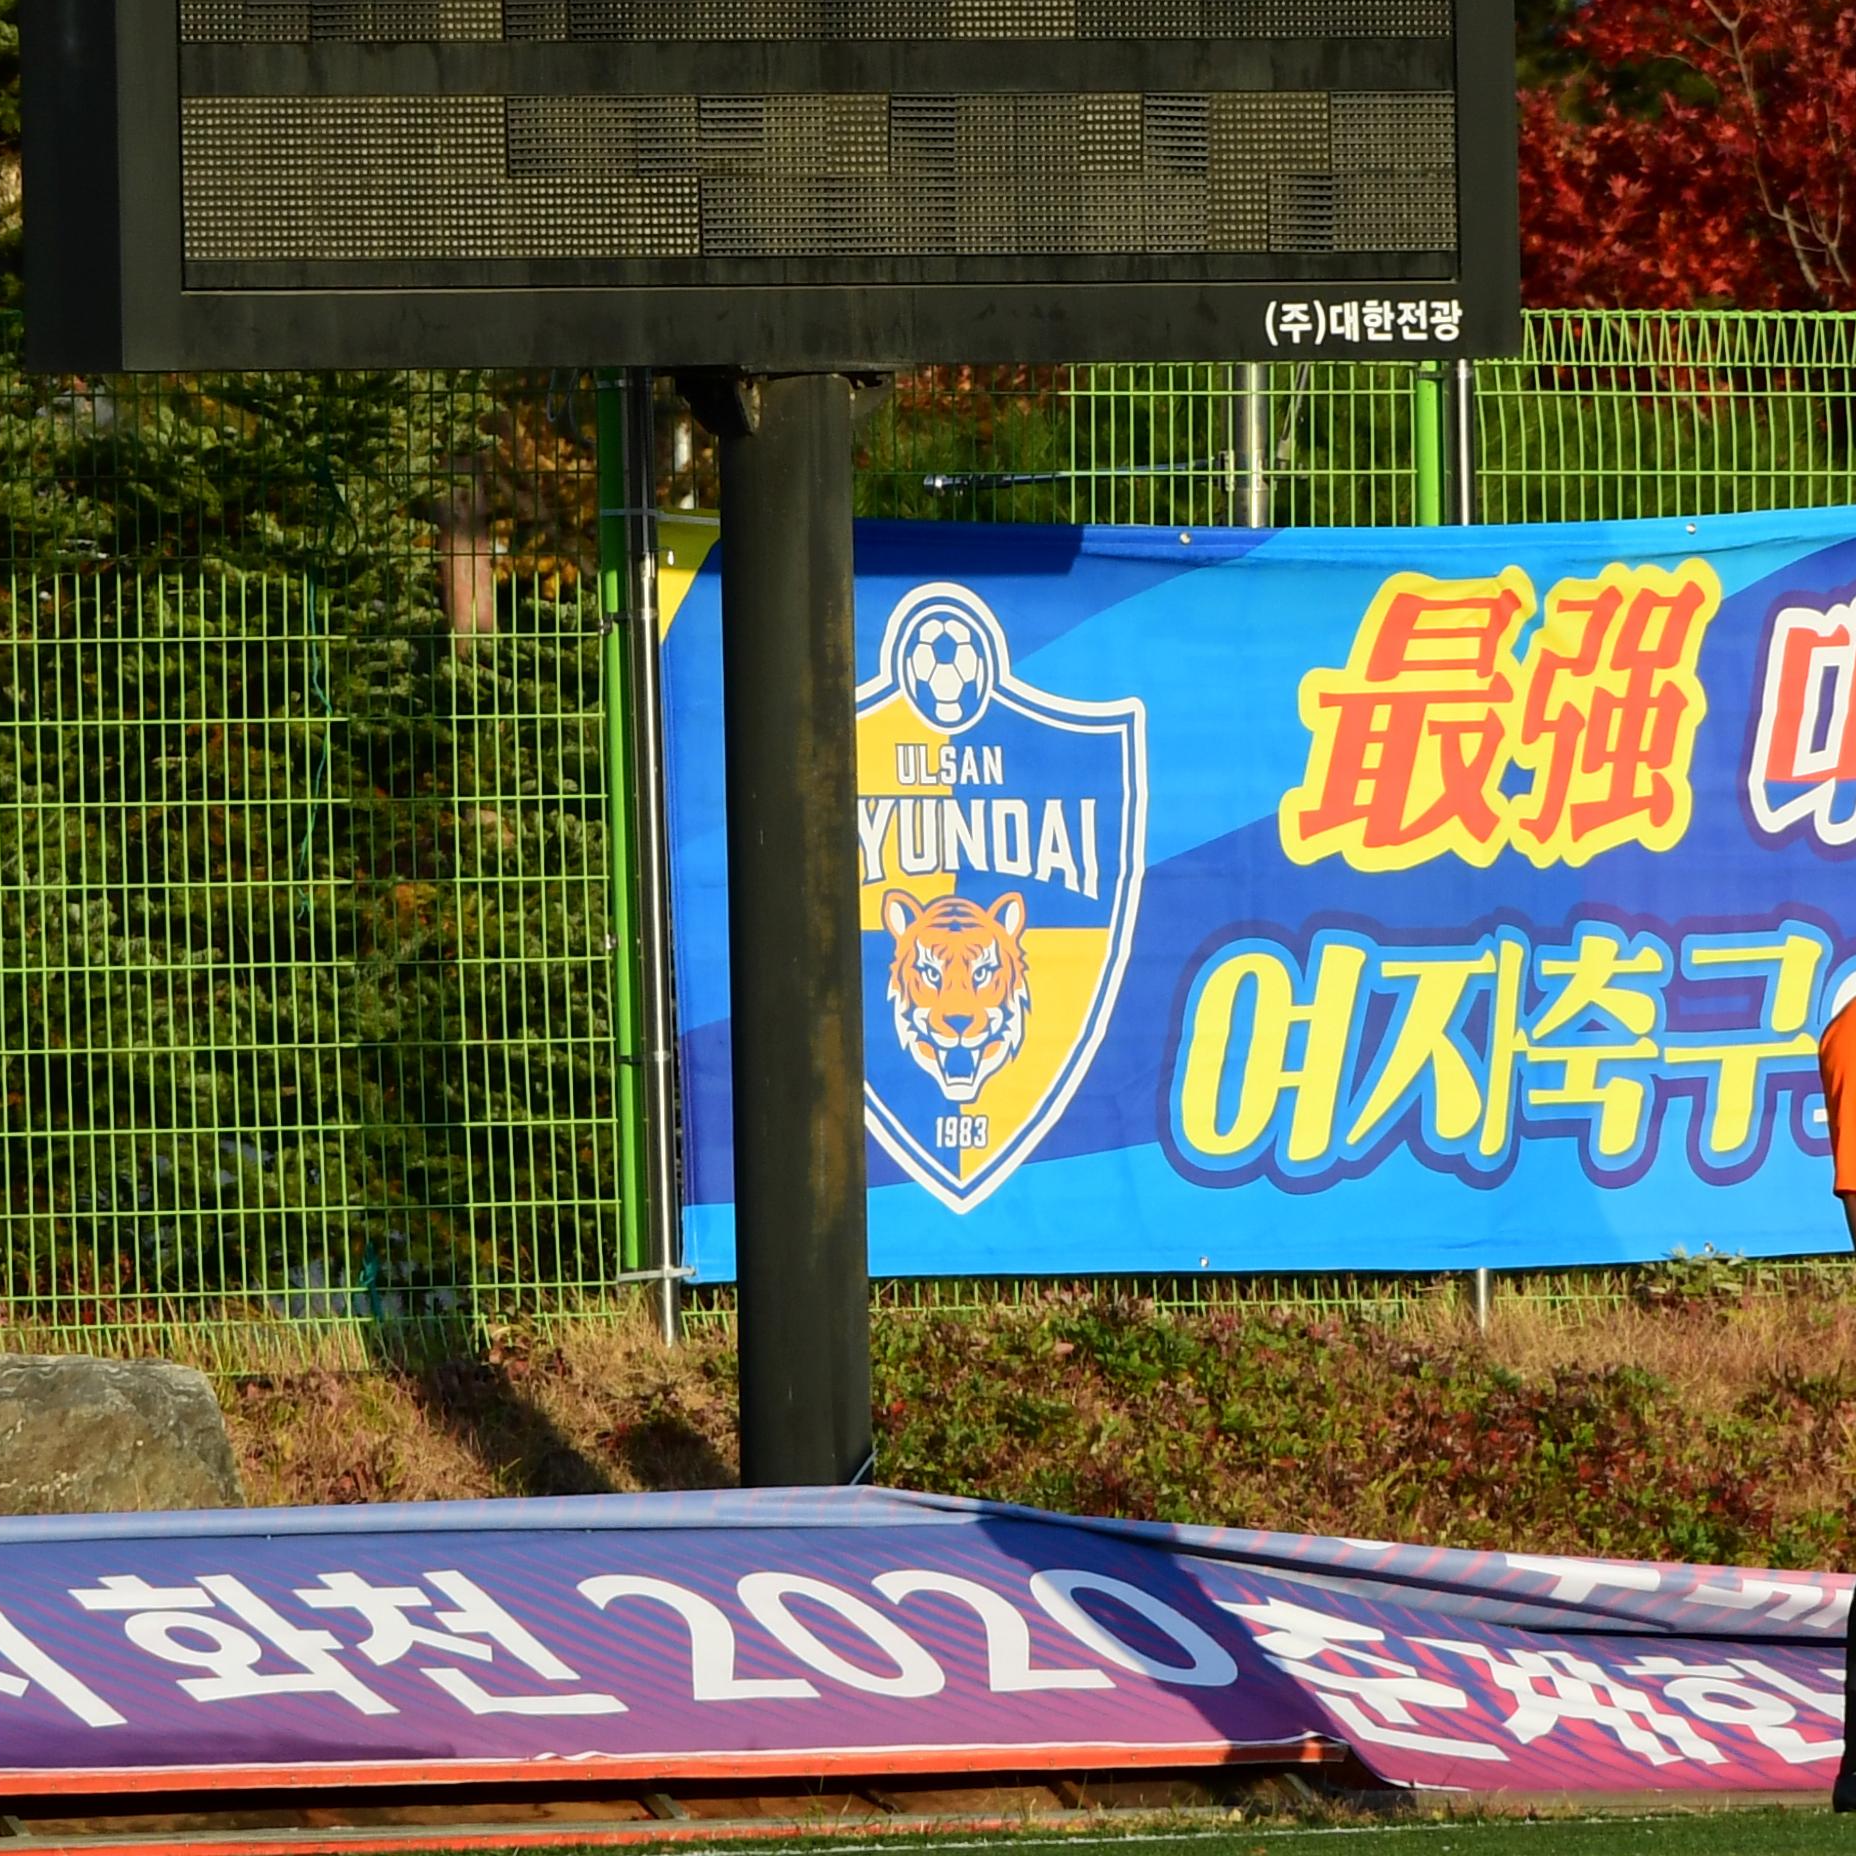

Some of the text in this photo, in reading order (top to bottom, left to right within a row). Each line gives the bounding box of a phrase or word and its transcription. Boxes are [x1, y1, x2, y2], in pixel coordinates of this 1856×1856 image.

[1264, 299, 1464, 347] (주)대한전광
[895, 744, 1004, 786] ULSAN
[856, 797, 1100, 902] YUNDAI
[934, 1116, 988, 1150] 1983
[66, 1570, 631, 1716] 화천
[575, 1567, 1240, 1702] 2020
